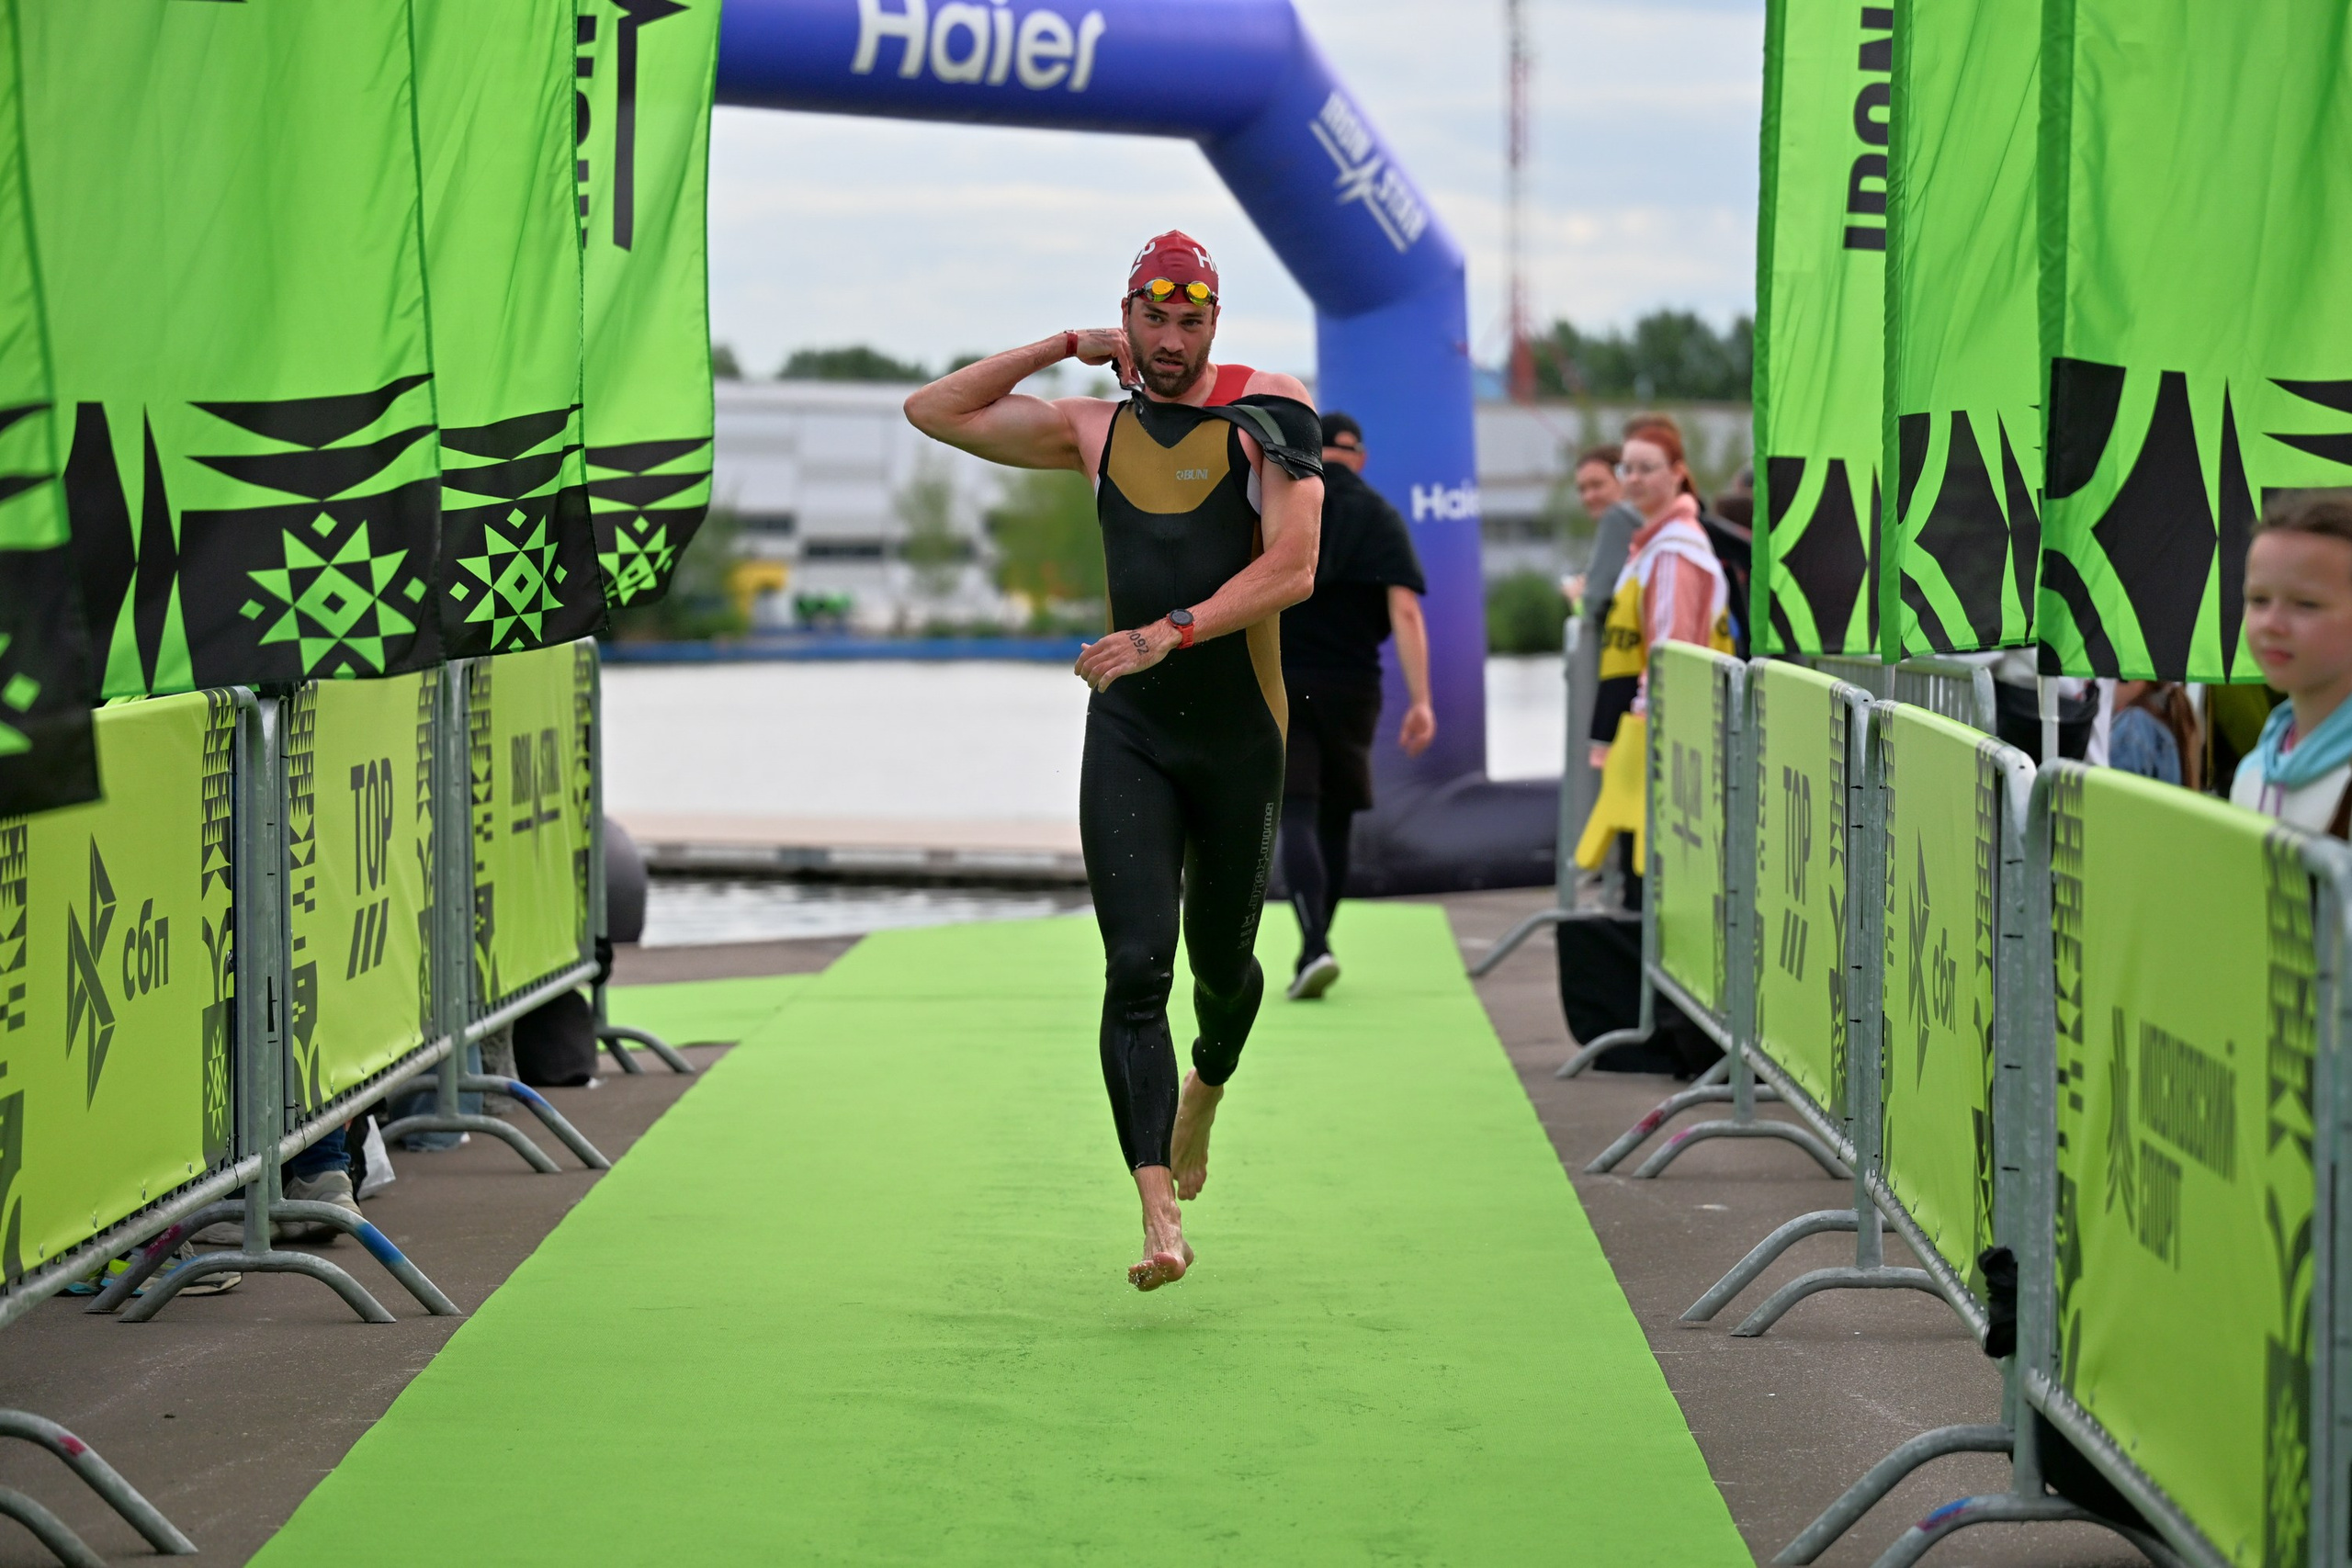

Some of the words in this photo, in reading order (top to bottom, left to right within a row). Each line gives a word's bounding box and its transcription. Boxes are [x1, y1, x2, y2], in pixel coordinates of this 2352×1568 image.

[850, 0, 1106, 93] Haier
[350, 757, 393, 897] TOP
[1783, 765, 1812, 906] TOP
[122, 897, 169, 1001] сбп
[1933, 928, 1956, 1034] сбп
